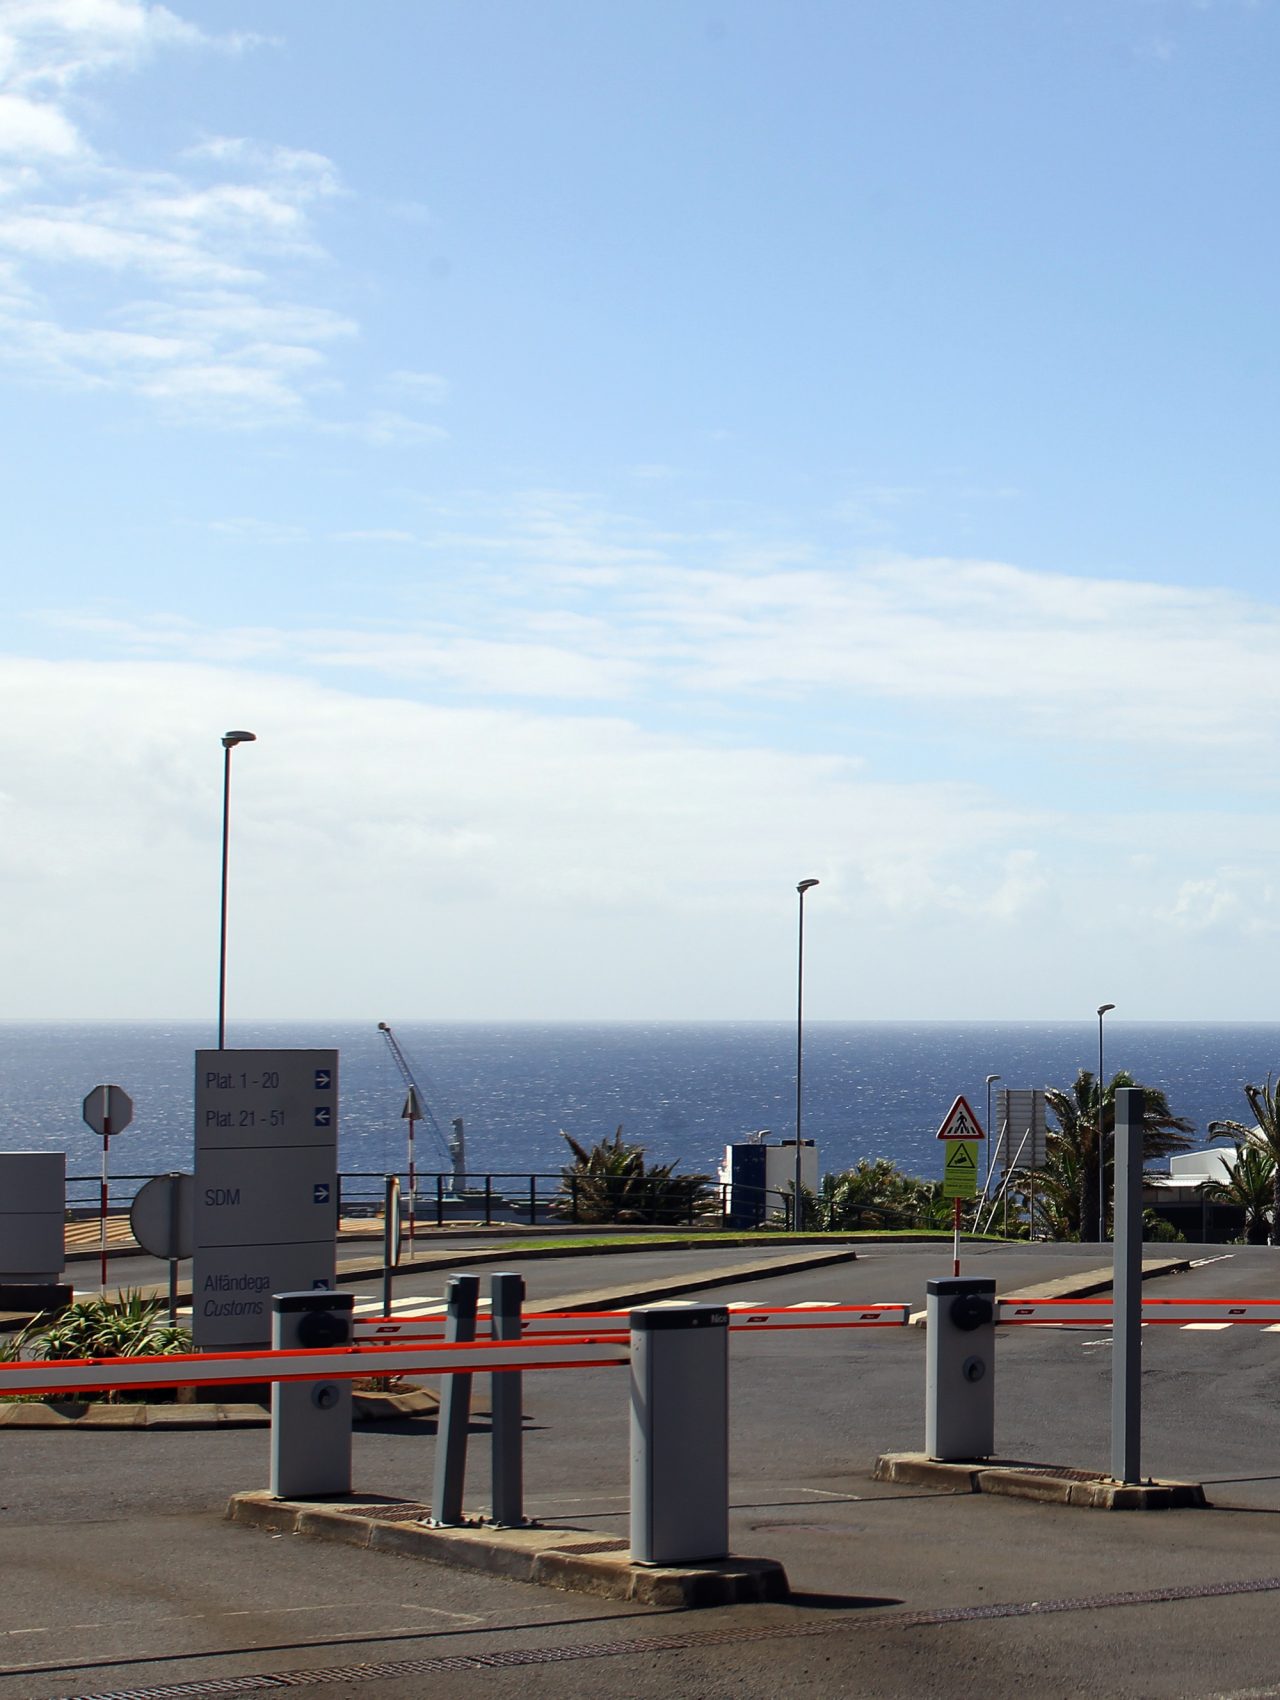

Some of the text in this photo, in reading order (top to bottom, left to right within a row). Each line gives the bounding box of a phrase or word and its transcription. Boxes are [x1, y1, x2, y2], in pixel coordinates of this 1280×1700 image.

[206, 1072, 236, 1089] Plat.
[240, 1072, 247, 1088] 1
[262, 1071, 280, 1089] 20
[206, 1110, 236, 1127] Plat.
[239, 1110, 255, 1127] 21
[270, 1109, 285, 1126] 51
[205, 1188, 240, 1206] SDM
[204, 1273, 271, 1294] Alfândega
[204, 1299, 264, 1317] Customs
